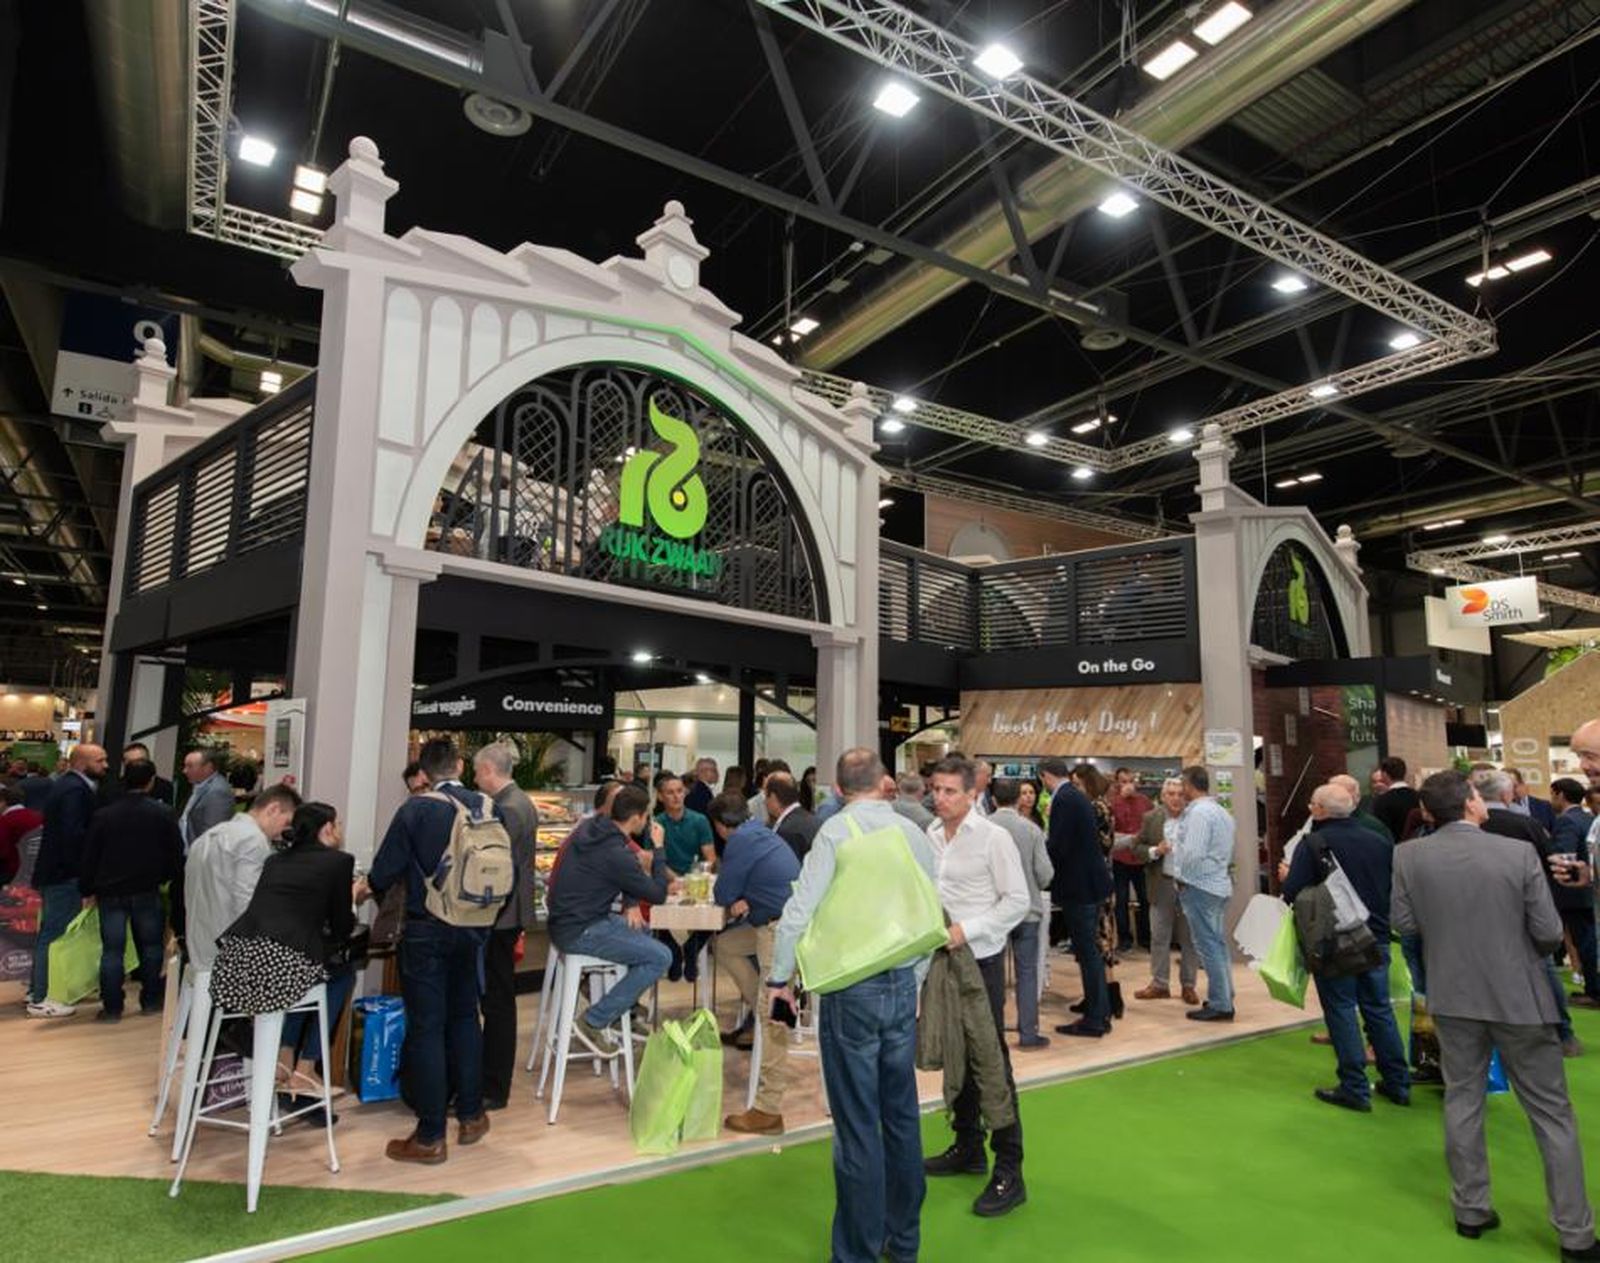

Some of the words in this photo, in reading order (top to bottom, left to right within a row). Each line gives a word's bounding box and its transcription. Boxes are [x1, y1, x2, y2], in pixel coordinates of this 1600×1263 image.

[80, 389, 117, 404] Salida
[1482, 606, 1524, 621] Smith
[1077, 660, 1100, 674] On
[1103, 659, 1128, 673] the
[1131, 657, 1155, 672] Go
[502, 694, 604, 715] Convenience
[991, 713, 1037, 737] Boost
[1044, 711, 1089, 734] Your
[1099, 708, 1139, 741] Day
